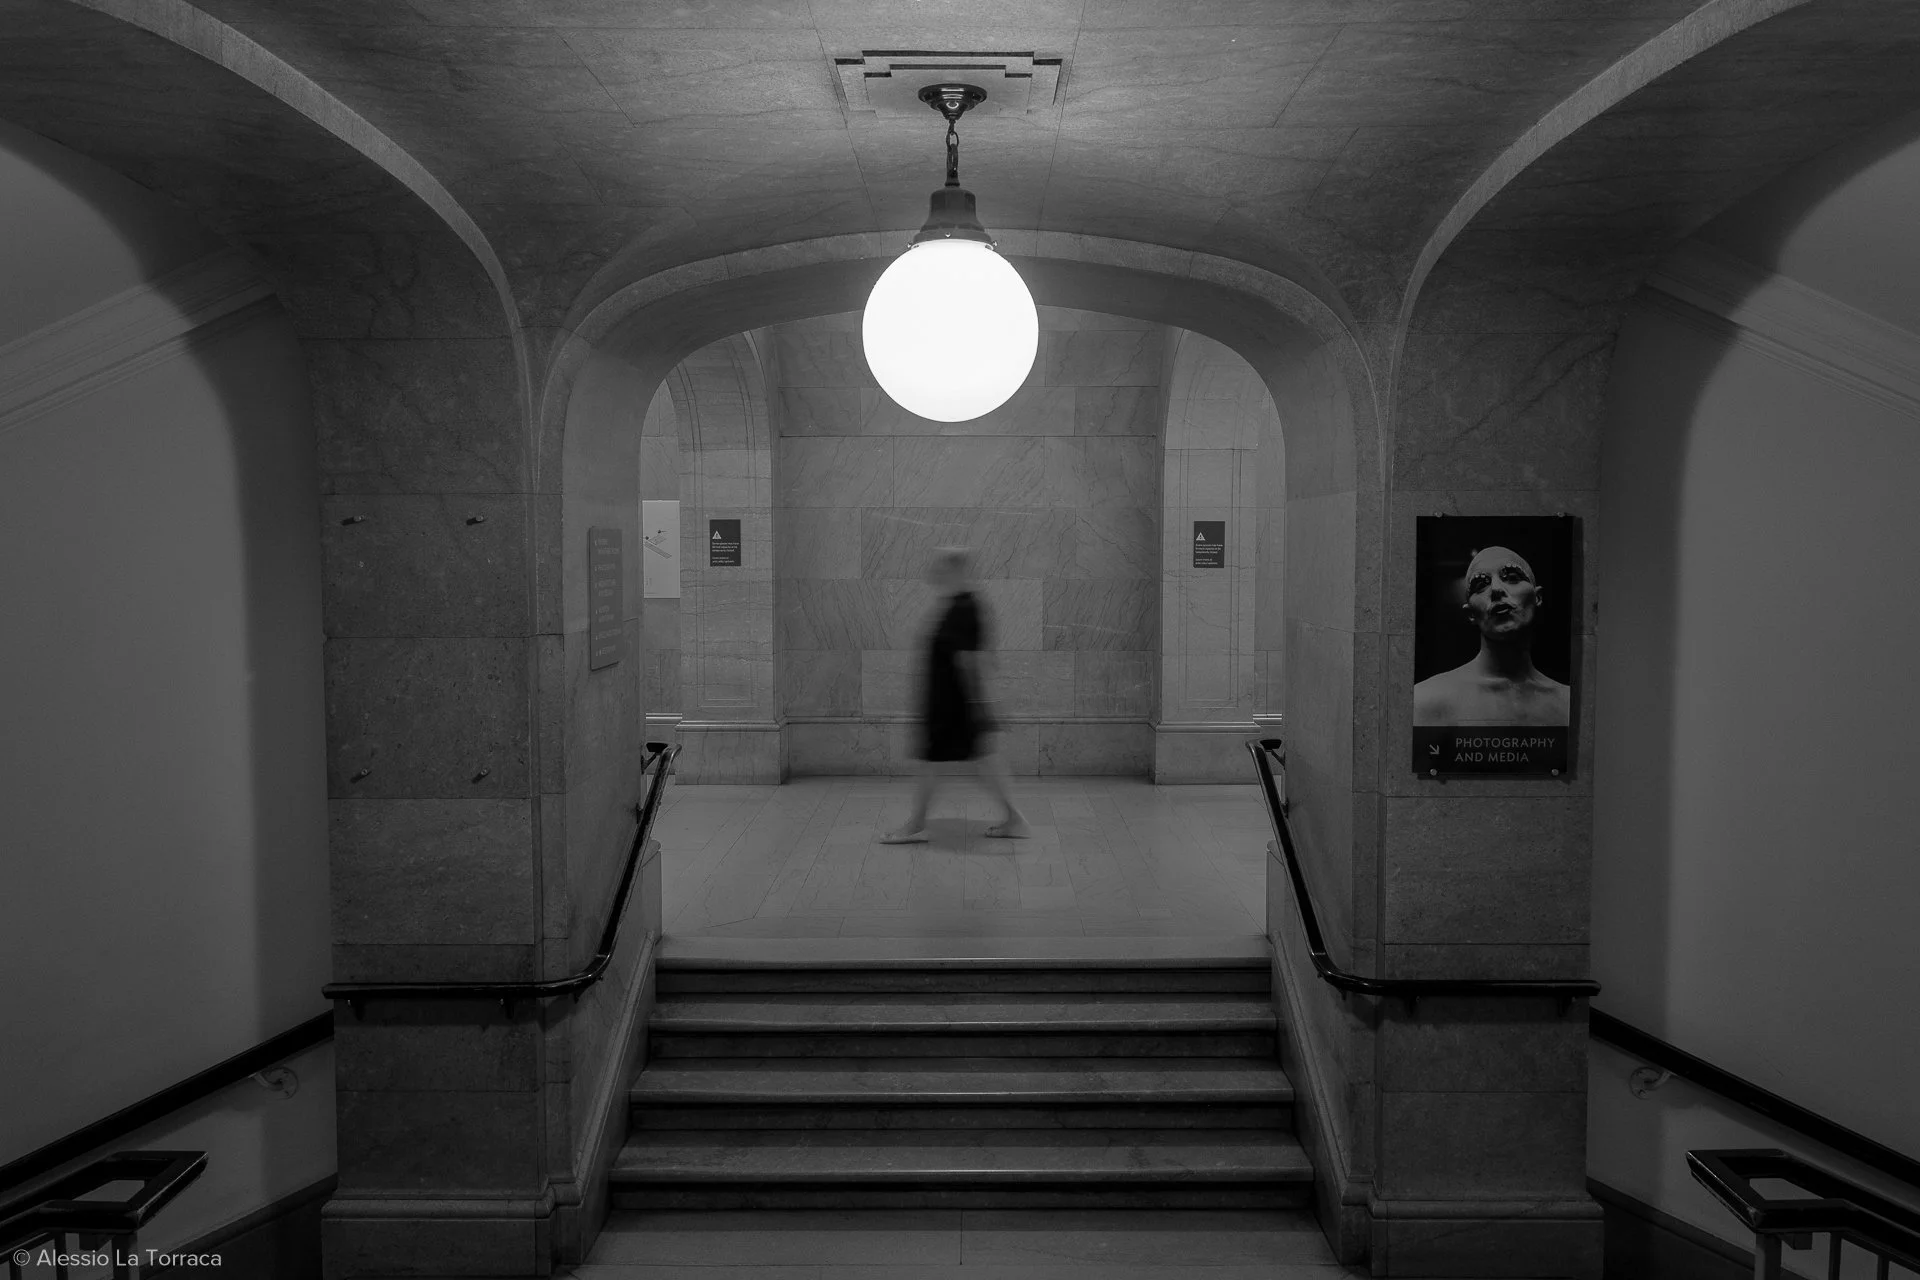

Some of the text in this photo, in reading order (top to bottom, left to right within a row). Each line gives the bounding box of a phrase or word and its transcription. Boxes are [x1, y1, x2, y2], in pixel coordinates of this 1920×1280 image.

[1455, 737, 1556, 748] PHOTOGRAPHY
[1454, 752, 1529, 762] AND MEDIA
